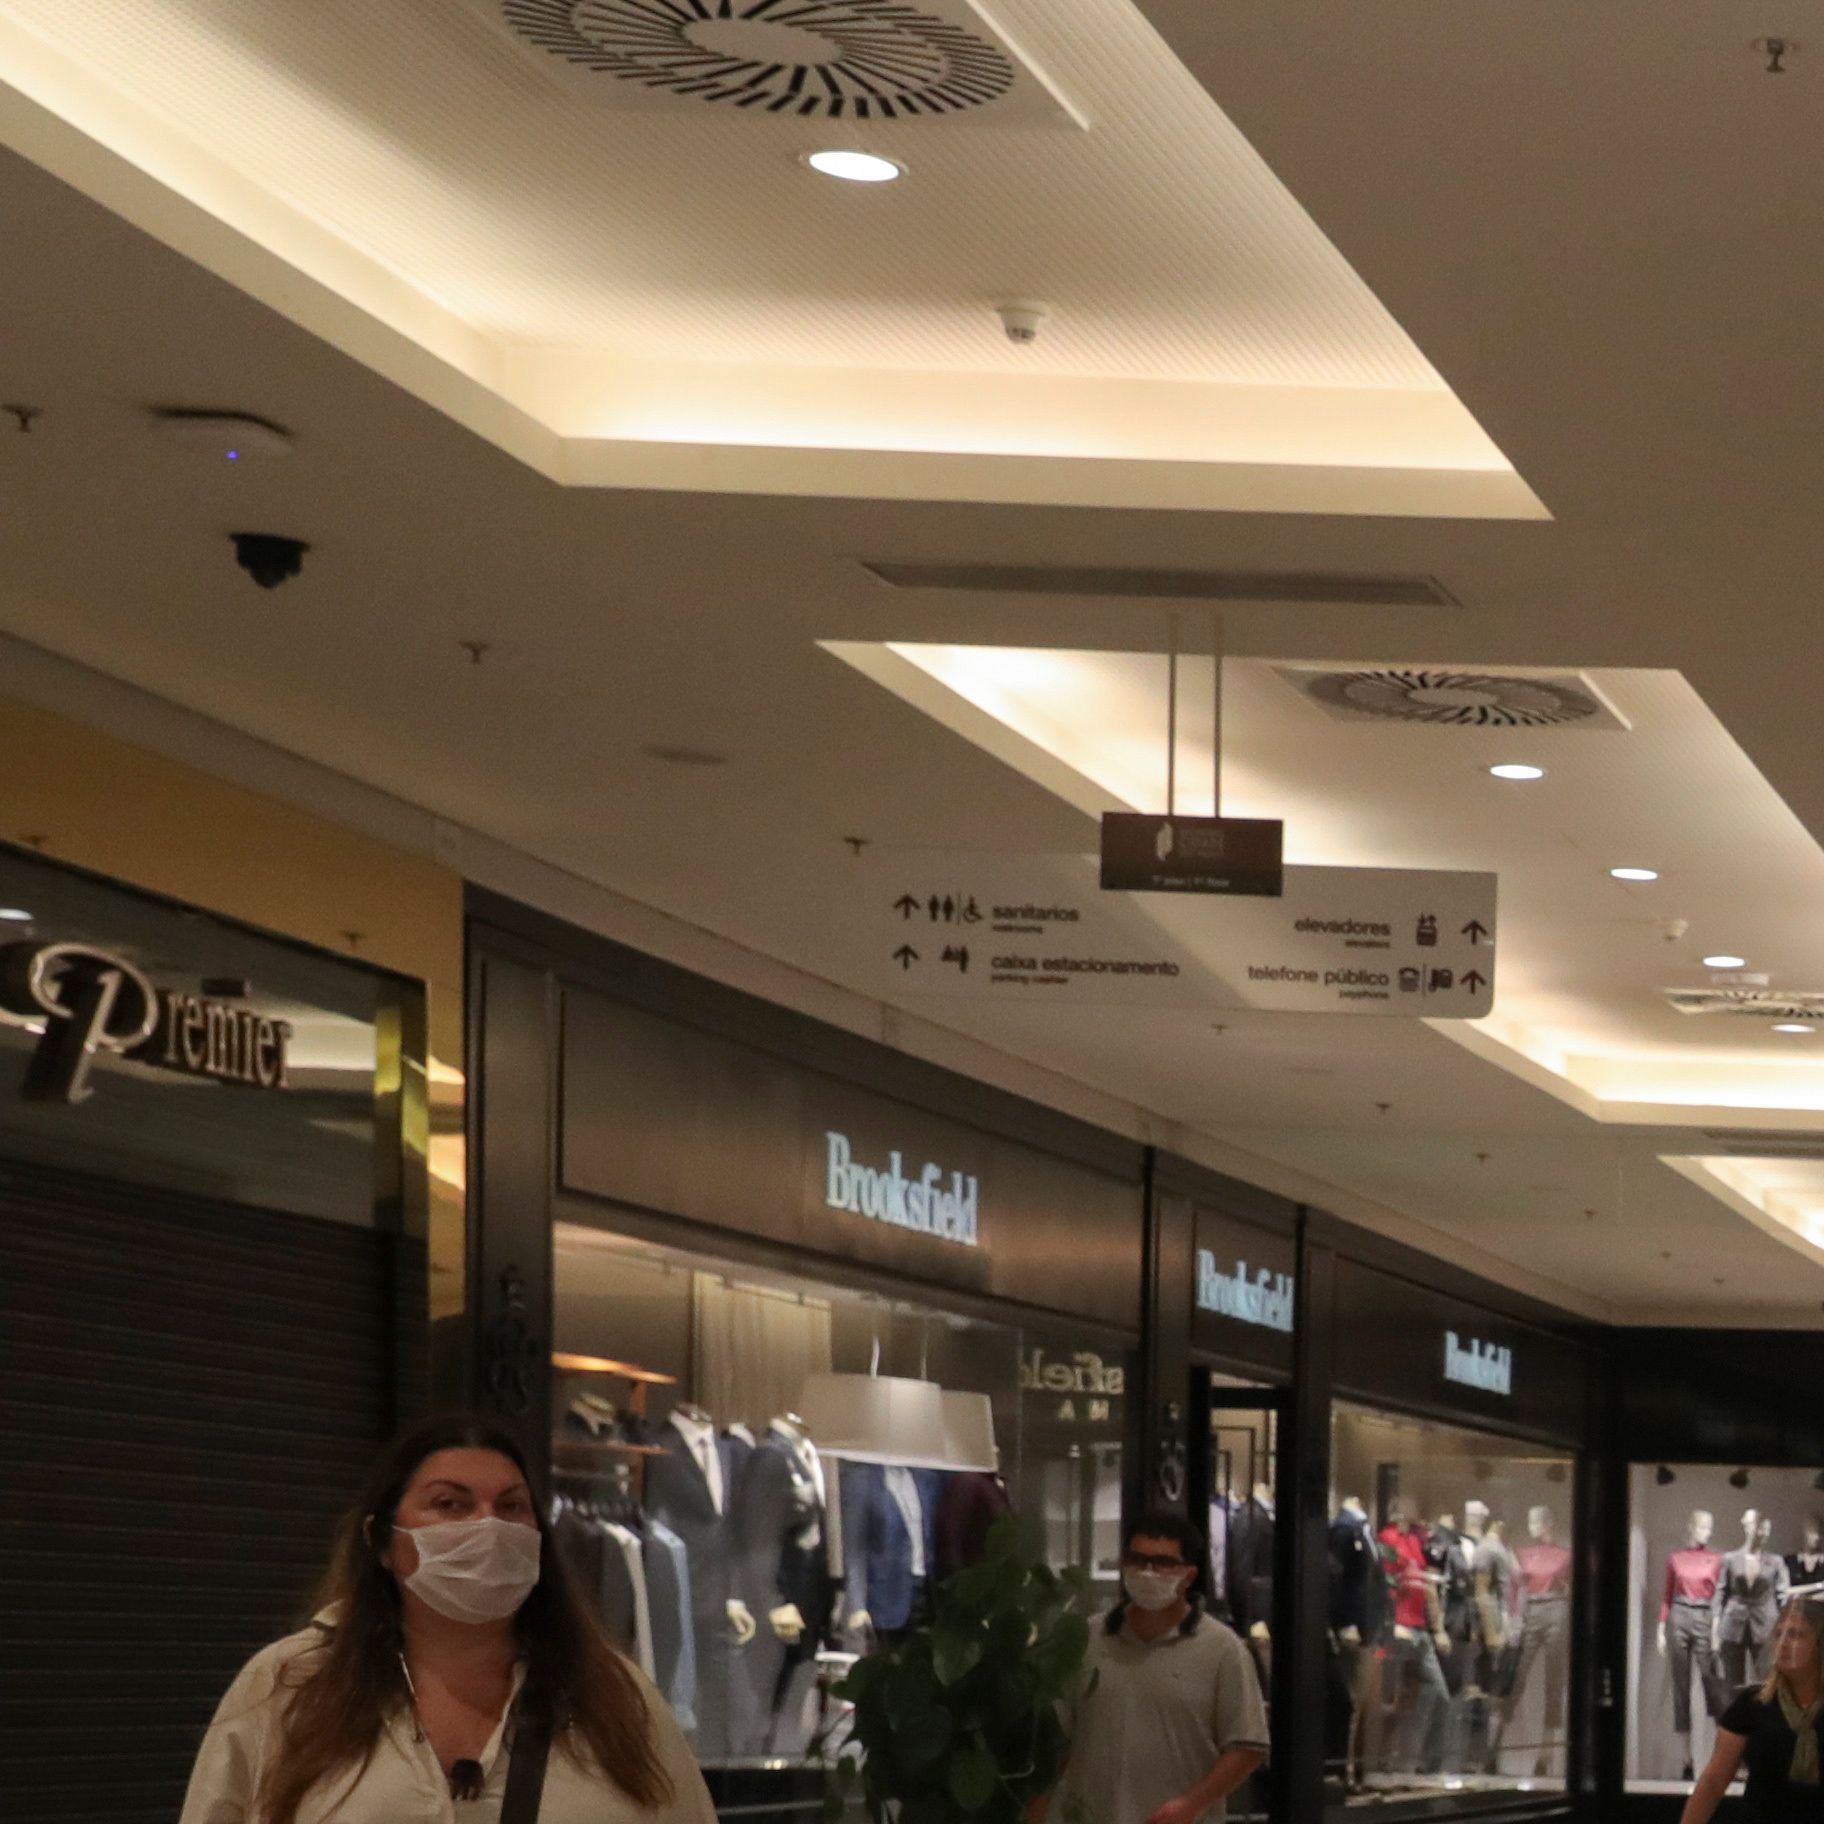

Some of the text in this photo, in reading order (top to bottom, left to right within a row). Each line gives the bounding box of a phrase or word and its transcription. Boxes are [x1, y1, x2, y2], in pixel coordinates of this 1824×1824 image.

[27, 942, 293, 1104] Premier
[825, 1130, 979, 1246] Brooksfield
[1196, 1248, 1295, 1332] Brooksfield
